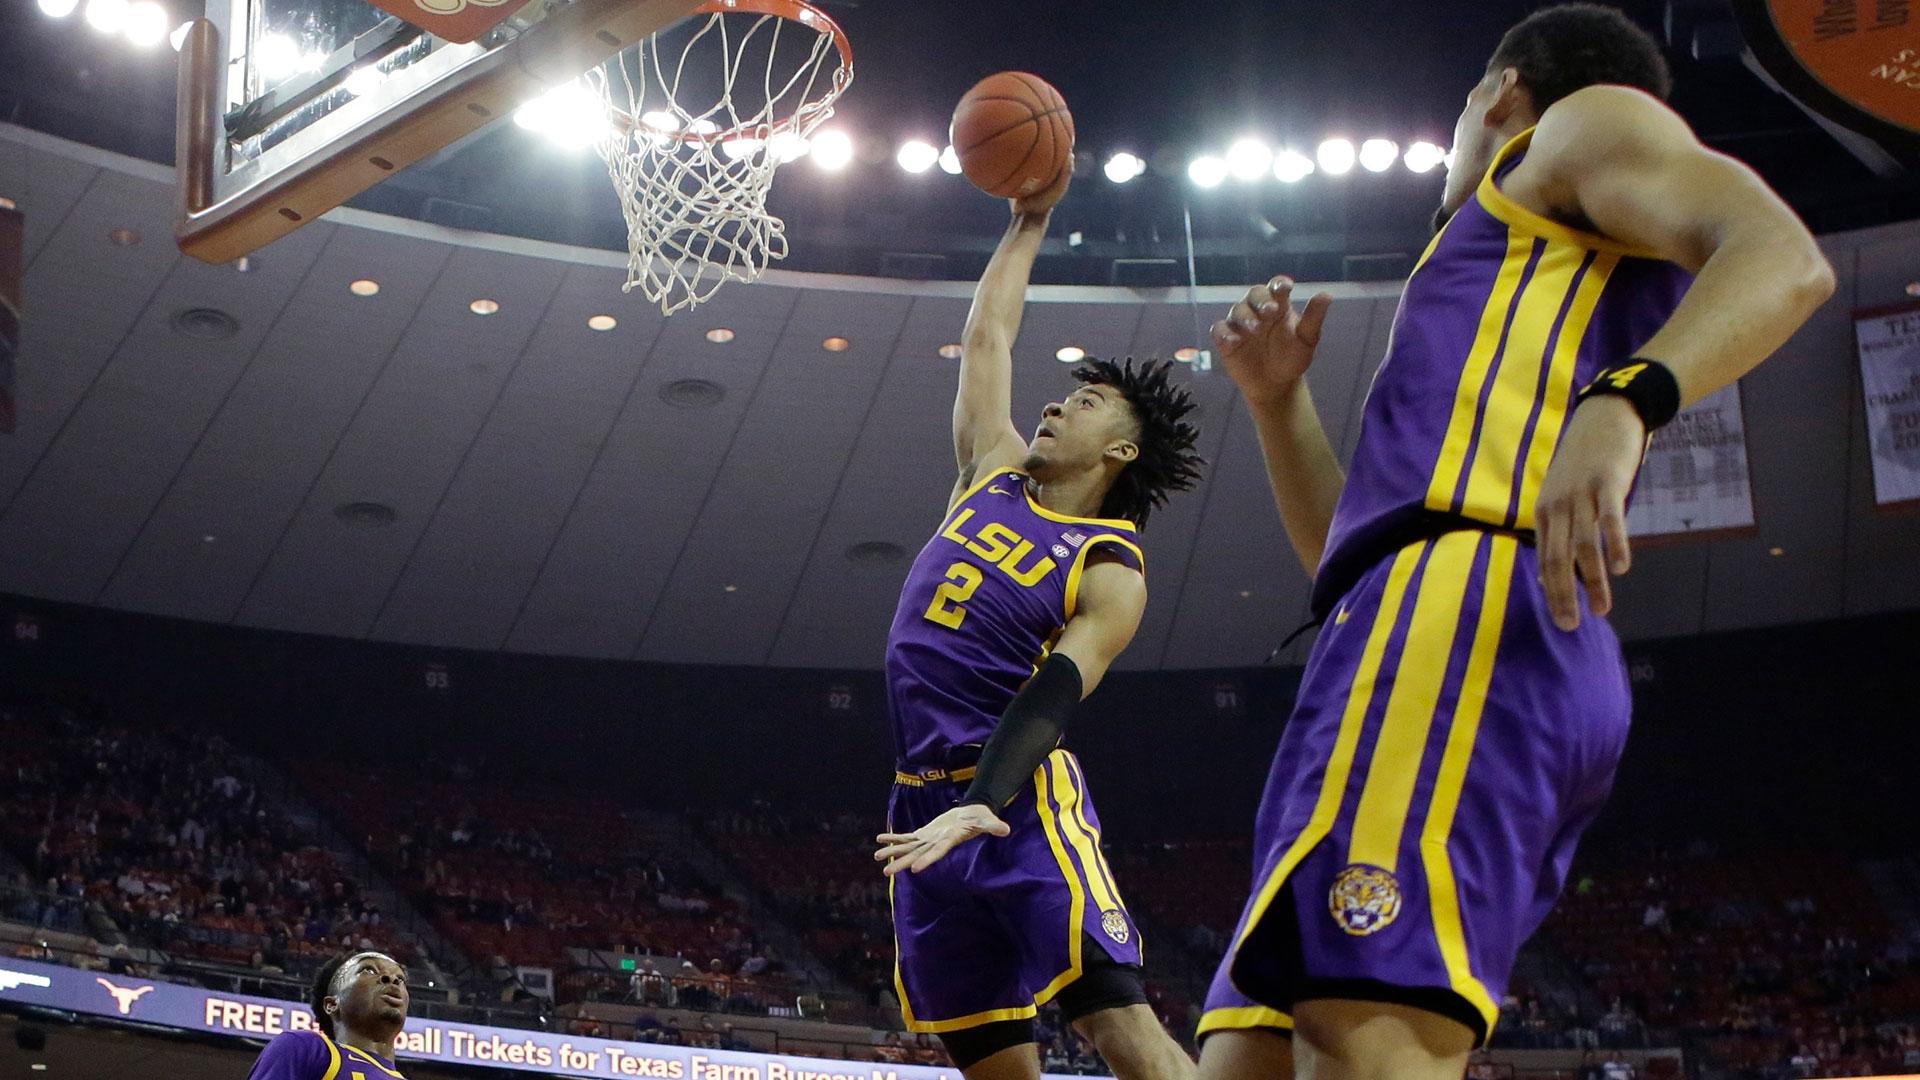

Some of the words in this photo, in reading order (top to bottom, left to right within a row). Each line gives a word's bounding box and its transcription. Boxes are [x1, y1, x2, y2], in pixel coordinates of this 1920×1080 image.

[941, 508, 1057, 588] LSU
[924, 561, 984, 630] 2
[920, 768, 947, 782] LSU
[206, 998, 284, 1034] FREE
[448, 1031, 552, 1066] Tickets
[559, 1043, 599, 1070] for
[604, 1047, 683, 1079] Texas
[690, 1055, 760, 1080] Farm
